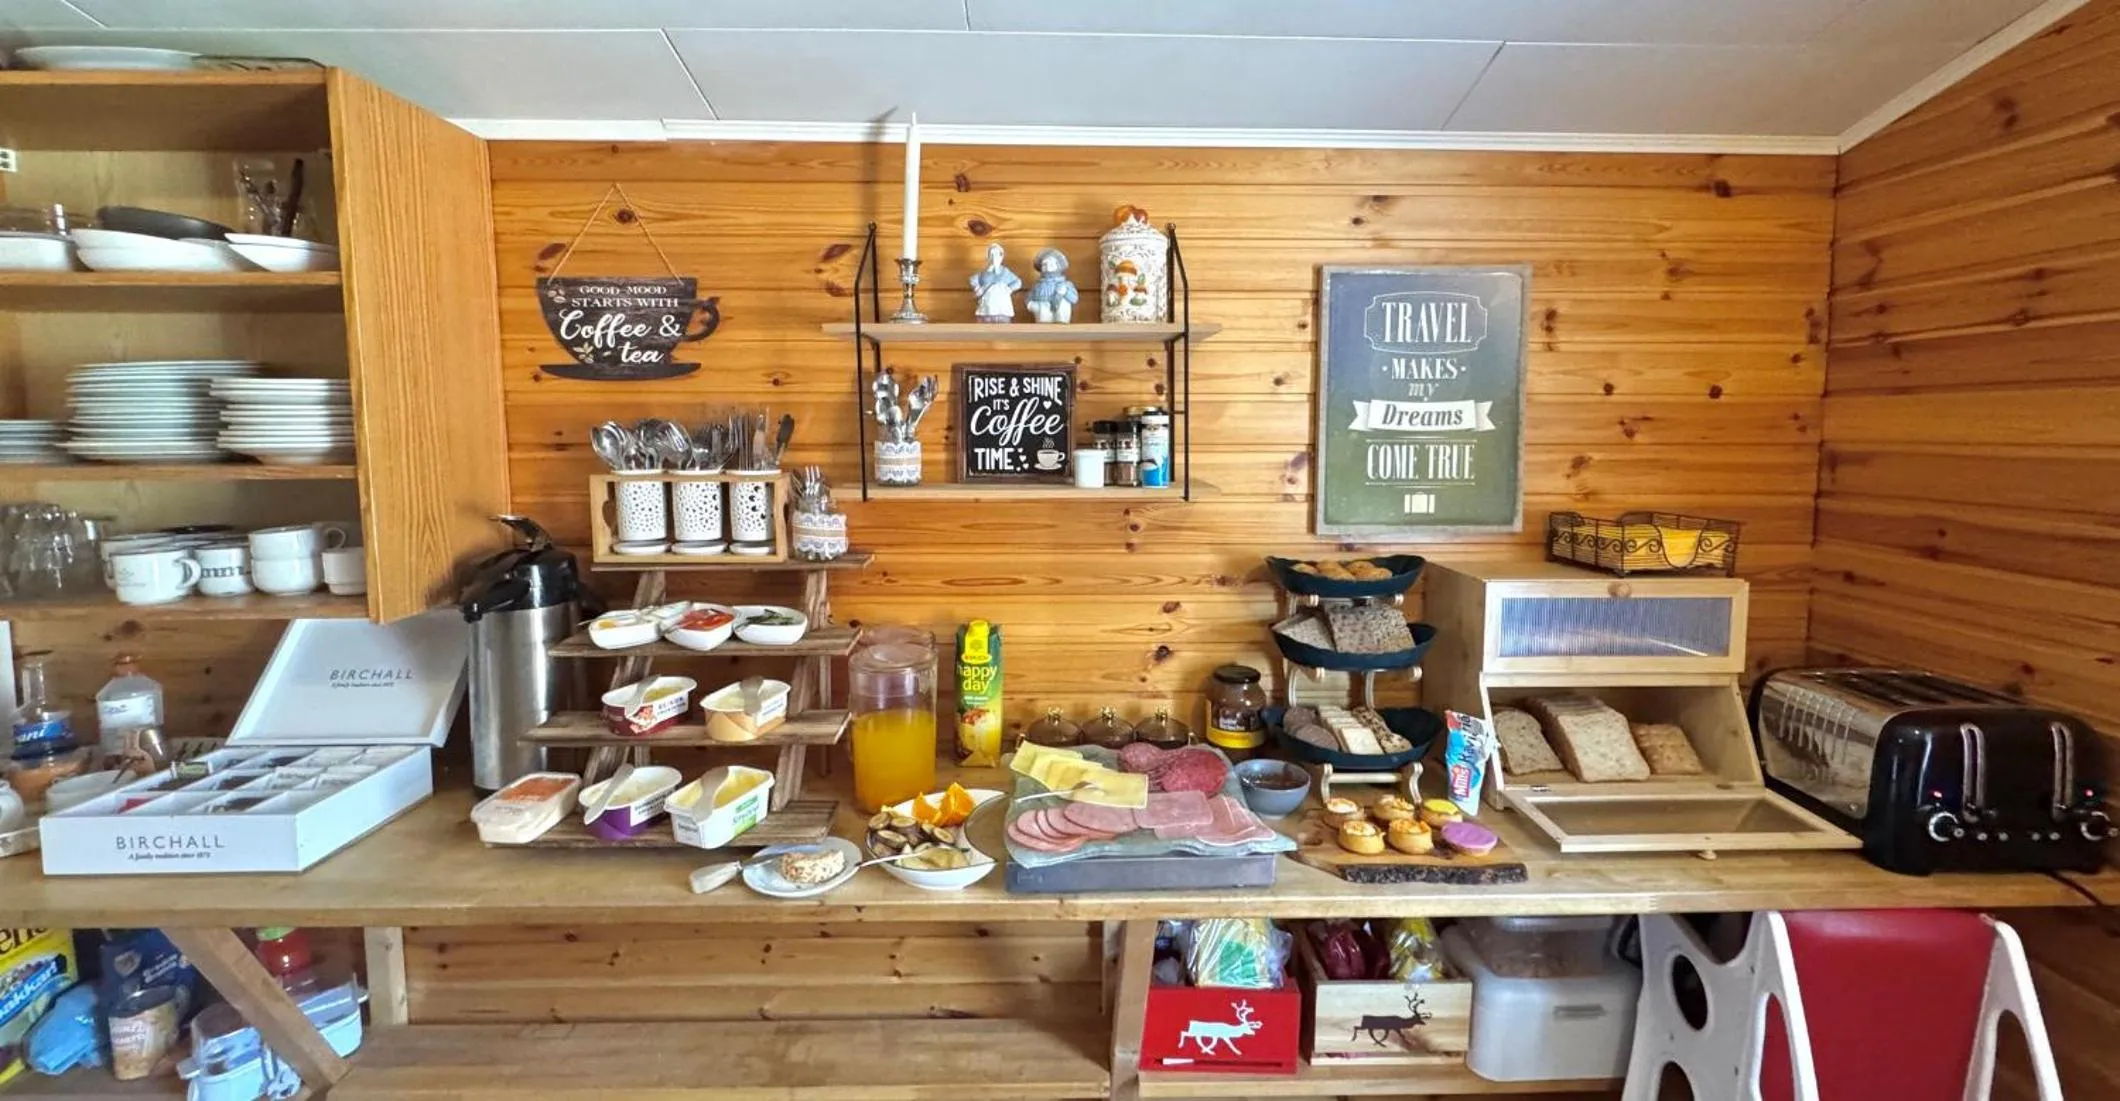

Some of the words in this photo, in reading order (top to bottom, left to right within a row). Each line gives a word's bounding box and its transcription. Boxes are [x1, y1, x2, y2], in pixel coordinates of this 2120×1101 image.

[580, 286, 620, 295] GOOD
[628, 286, 667, 295] MOOD
[571, 298, 632, 307] STARTS
[635, 298, 679, 307] WITH
[559, 309, 652, 348] Coffee
[660, 314, 682, 337] &
[1381, 302, 1472, 343] TRAVEL
[618, 341, 664, 363] tea
[1391, 358, 1458, 380] MAKES
[969, 376, 1006, 402] RISE
[1009, 377, 1020, 397] &
[1023, 377, 1063, 406] SHINE
[993, 399, 1010, 410] IT'S
[1381, 404, 1464, 426] Dreams
[971, 397, 1064, 446] Coffee
[974, 448, 1015, 470] TIME
[1367, 444, 1420, 479] COME
[1425, 444, 1476, 479] TRUE
[330, 668, 414, 681] BIRCHALL
[963, 676, 990, 695] day
[116, 835, 225, 850] BIRCHALL
